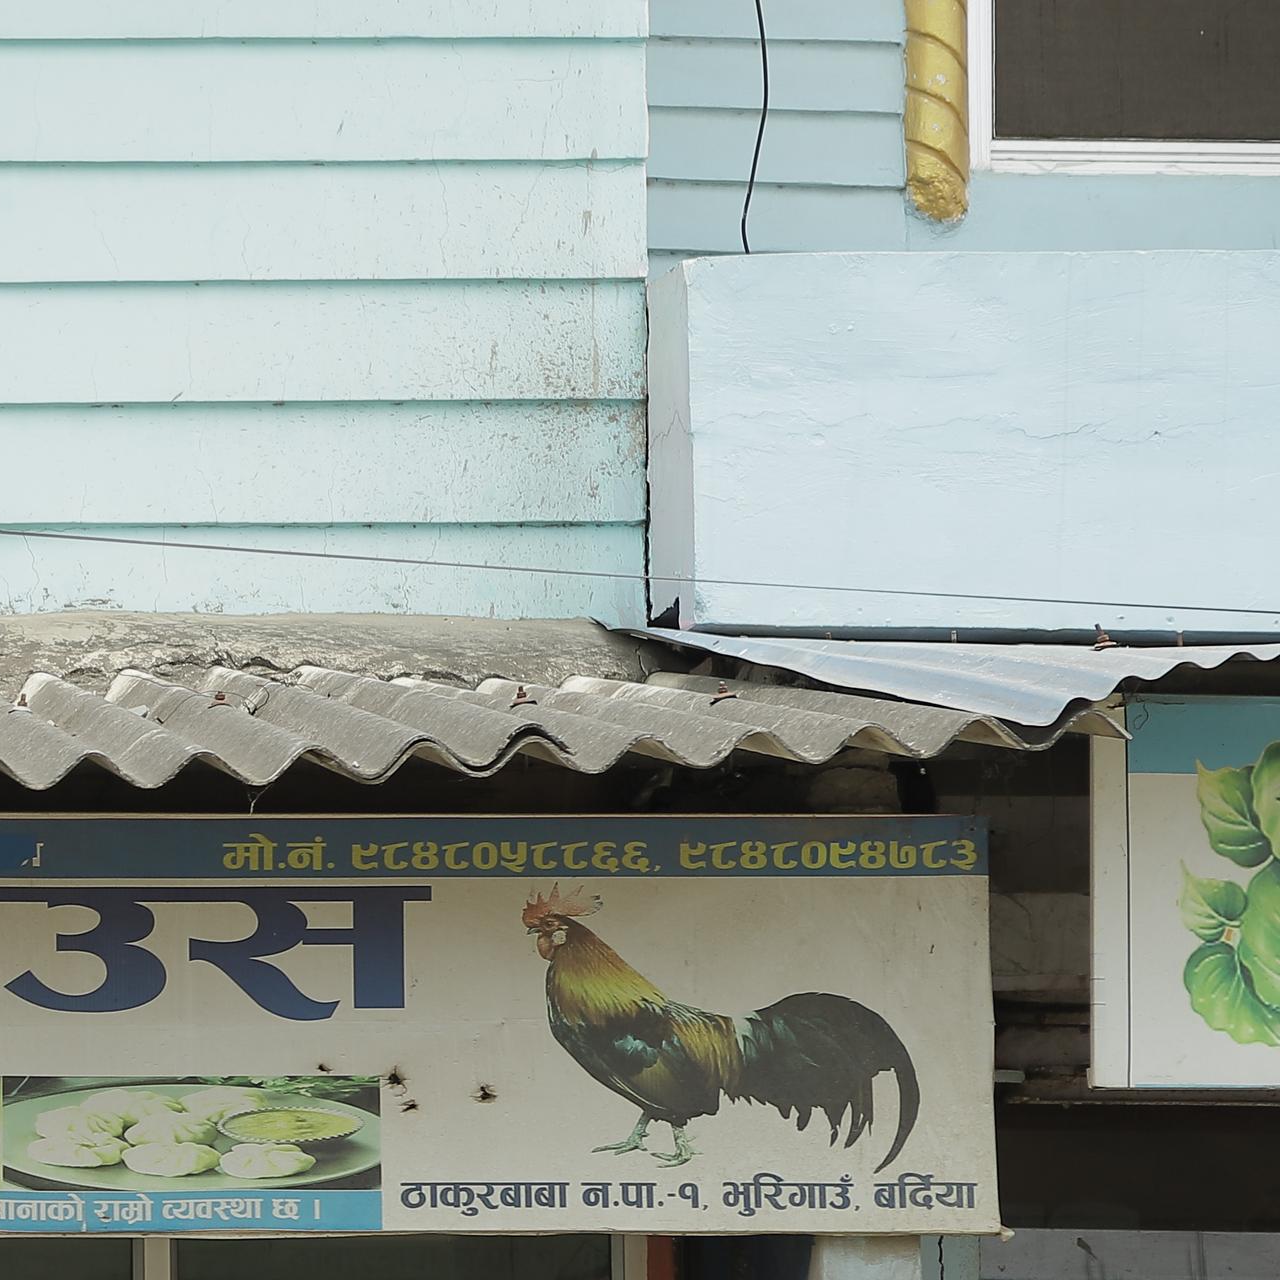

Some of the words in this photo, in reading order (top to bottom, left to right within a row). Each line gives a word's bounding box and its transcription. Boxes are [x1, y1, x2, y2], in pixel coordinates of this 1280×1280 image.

[162, 1198, 263, 1222] व्यवस्था
[272, 1197, 301, 1221] छ
[400, 1181, 570, 1215] ठाकुरबाबा
[872, 1174, 978, 1212] बर्दिया
